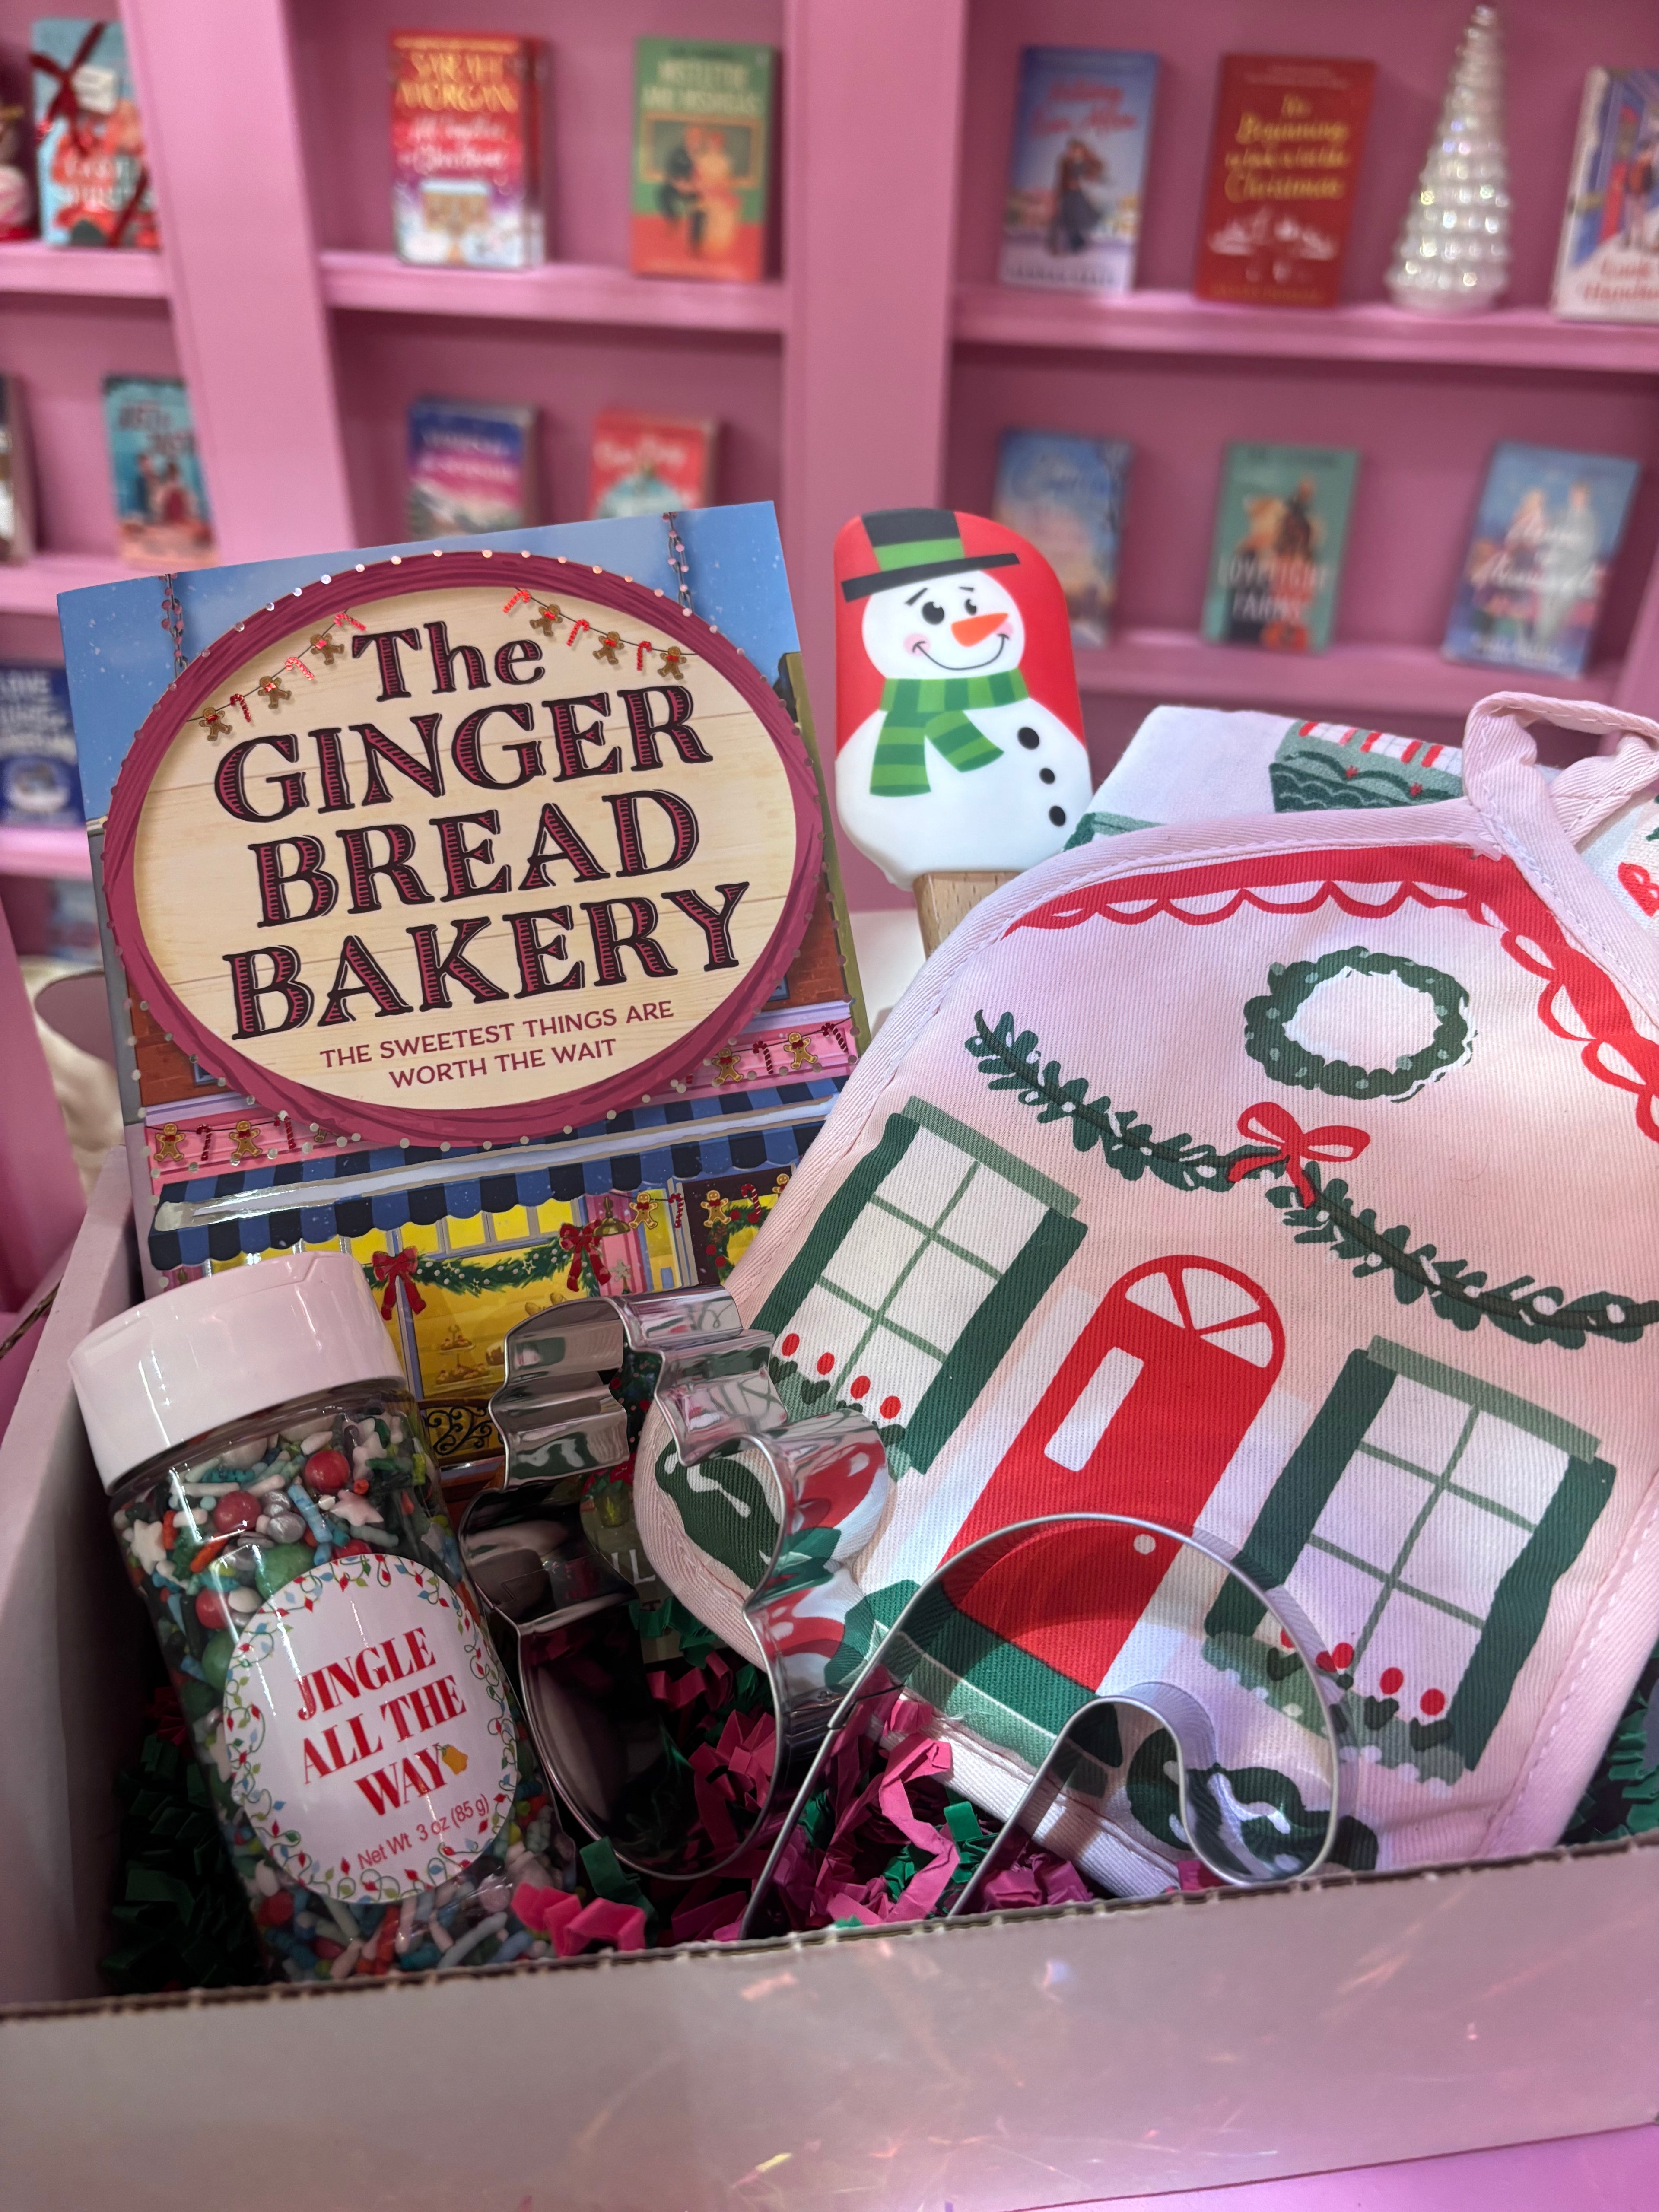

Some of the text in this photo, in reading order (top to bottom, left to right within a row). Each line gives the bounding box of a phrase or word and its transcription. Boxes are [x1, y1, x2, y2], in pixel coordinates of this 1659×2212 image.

[351, 621, 545, 702] The
[213, 685, 714, 823] GINGER
[248, 789, 700, 928] BREAD
[223, 881, 750, 1040] BAKERY
[320, 1000, 674, 1068] THE SWEETEST THINGS ARE
[389, 1039, 617, 1088] WORTH THE WAIT
[294, 1627, 436, 1722] JINGLE
[303, 1675, 467, 1785] ALL THE
[354, 1742, 448, 1816] WAY
[358, 1793, 489, 1870] Net Wt 3 oz (85 g)
